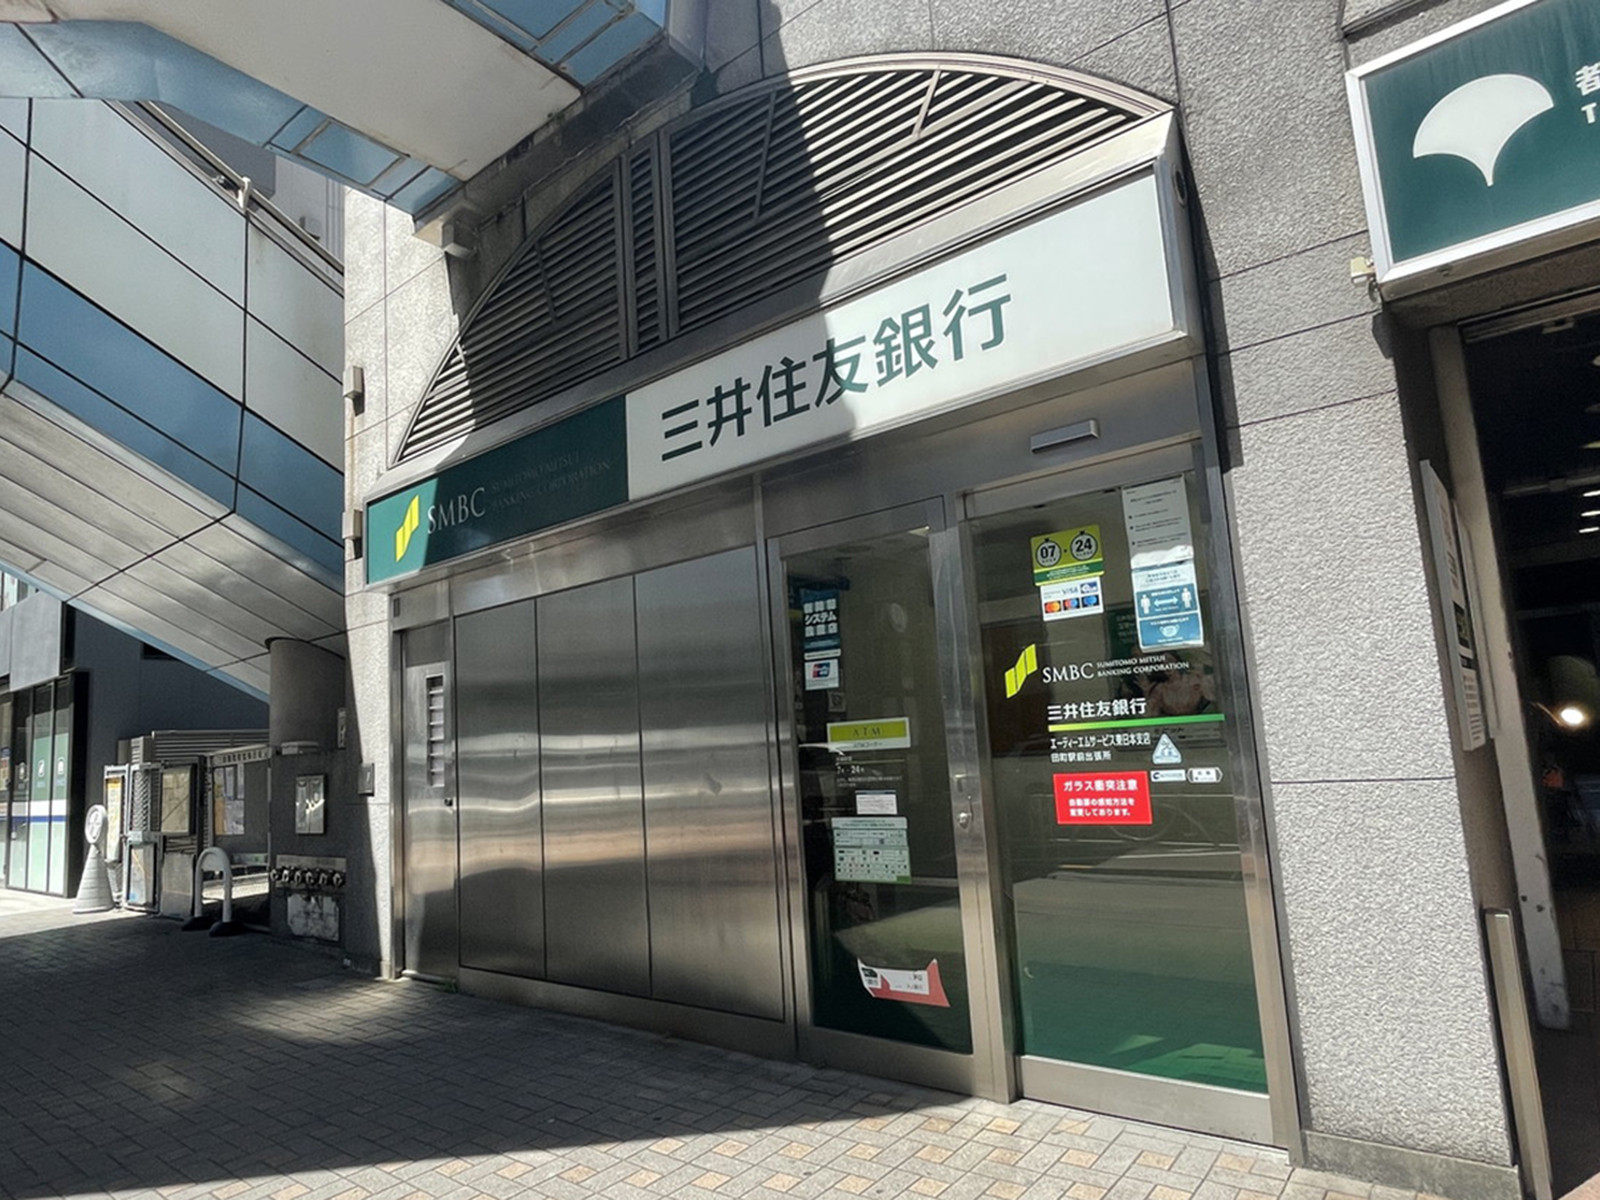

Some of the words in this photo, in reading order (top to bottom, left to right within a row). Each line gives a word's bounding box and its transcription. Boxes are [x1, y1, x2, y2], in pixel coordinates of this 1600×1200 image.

[661, 273, 1012, 462] 三井住友銀行
[426, 486, 487, 536] SMBC
[1040, 545, 1056, 559] 07
[1075, 538, 1093, 552] 24
[804, 611, 837, 625] システム
[1097, 657, 1138, 668] SUMITOMO
[1139, 655, 1166, 664] MITSUI
[1097, 666, 1132, 677] BANKING
[1133, 661, 1189, 675] CORPORATION
[1042, 662, 1095, 684] SMBC
[1047, 697, 1147, 720] 三井住友銀行
[852, 727, 882, 738] ATM
[1049, 732, 1151, 750] エーティーエムサービス東日本支店
[1063, 778, 1139, 793] ガラス衝突注意
